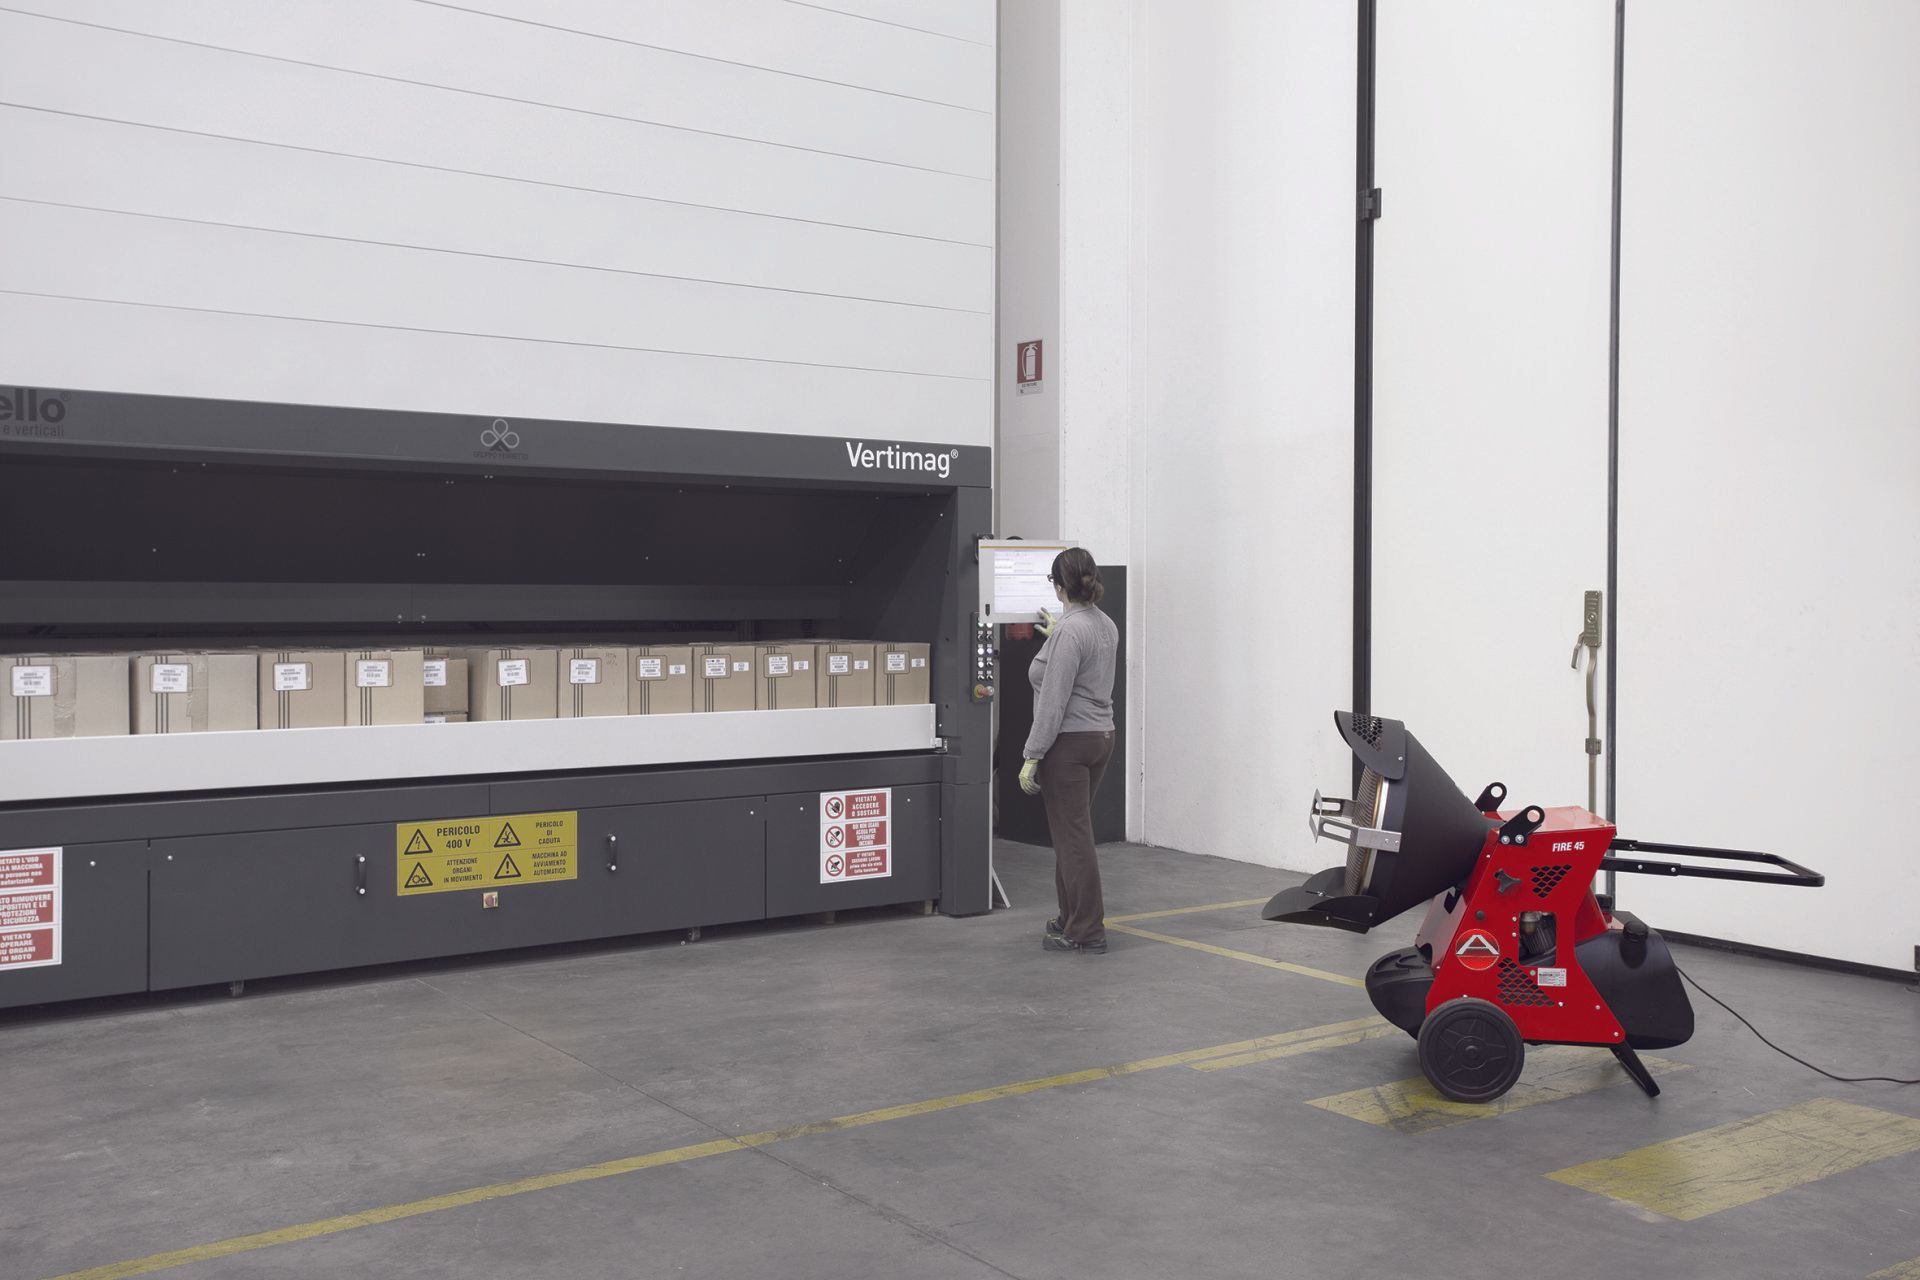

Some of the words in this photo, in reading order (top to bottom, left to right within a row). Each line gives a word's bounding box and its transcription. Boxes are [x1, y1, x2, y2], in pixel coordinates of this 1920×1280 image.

[15, 424, 64, 437] verticali
[855, 795, 877, 803] VIETATO
[852, 802, 880, 810] ACCEDERE
[857, 809, 880, 817] SOSTARE
[535, 820, 564, 828] PERICOLO
[436, 825, 481, 837] PERICOLO
[445, 839, 463, 849] 400
[465, 838, 472, 848] V
[538, 837, 561, 845] CADUTA
[1552, 841, 1573, 852] FIRE
[1574, 841, 1585, 851] 45
[532, 851, 559, 859] MACCHINA
[446, 857, 478, 866] ATTENZIONE
[533, 859, 566, 867] AVVIAMENTO
[11, 863, 43, 871] MACCHINA
[533, 867, 566, 876] AUTOMATICO
[450, 874, 483, 883] MOVIMENTO
[11, 894, 51, 903] RIMUOVERE
[3, 915, 40, 925] SICUREZZA
[2, 932, 31, 941] VIETATO
[0, 939, 33, 948] OPERARE
[9, 946, 36, 954] ORGANI
[10, 953, 32, 961] MOTO
